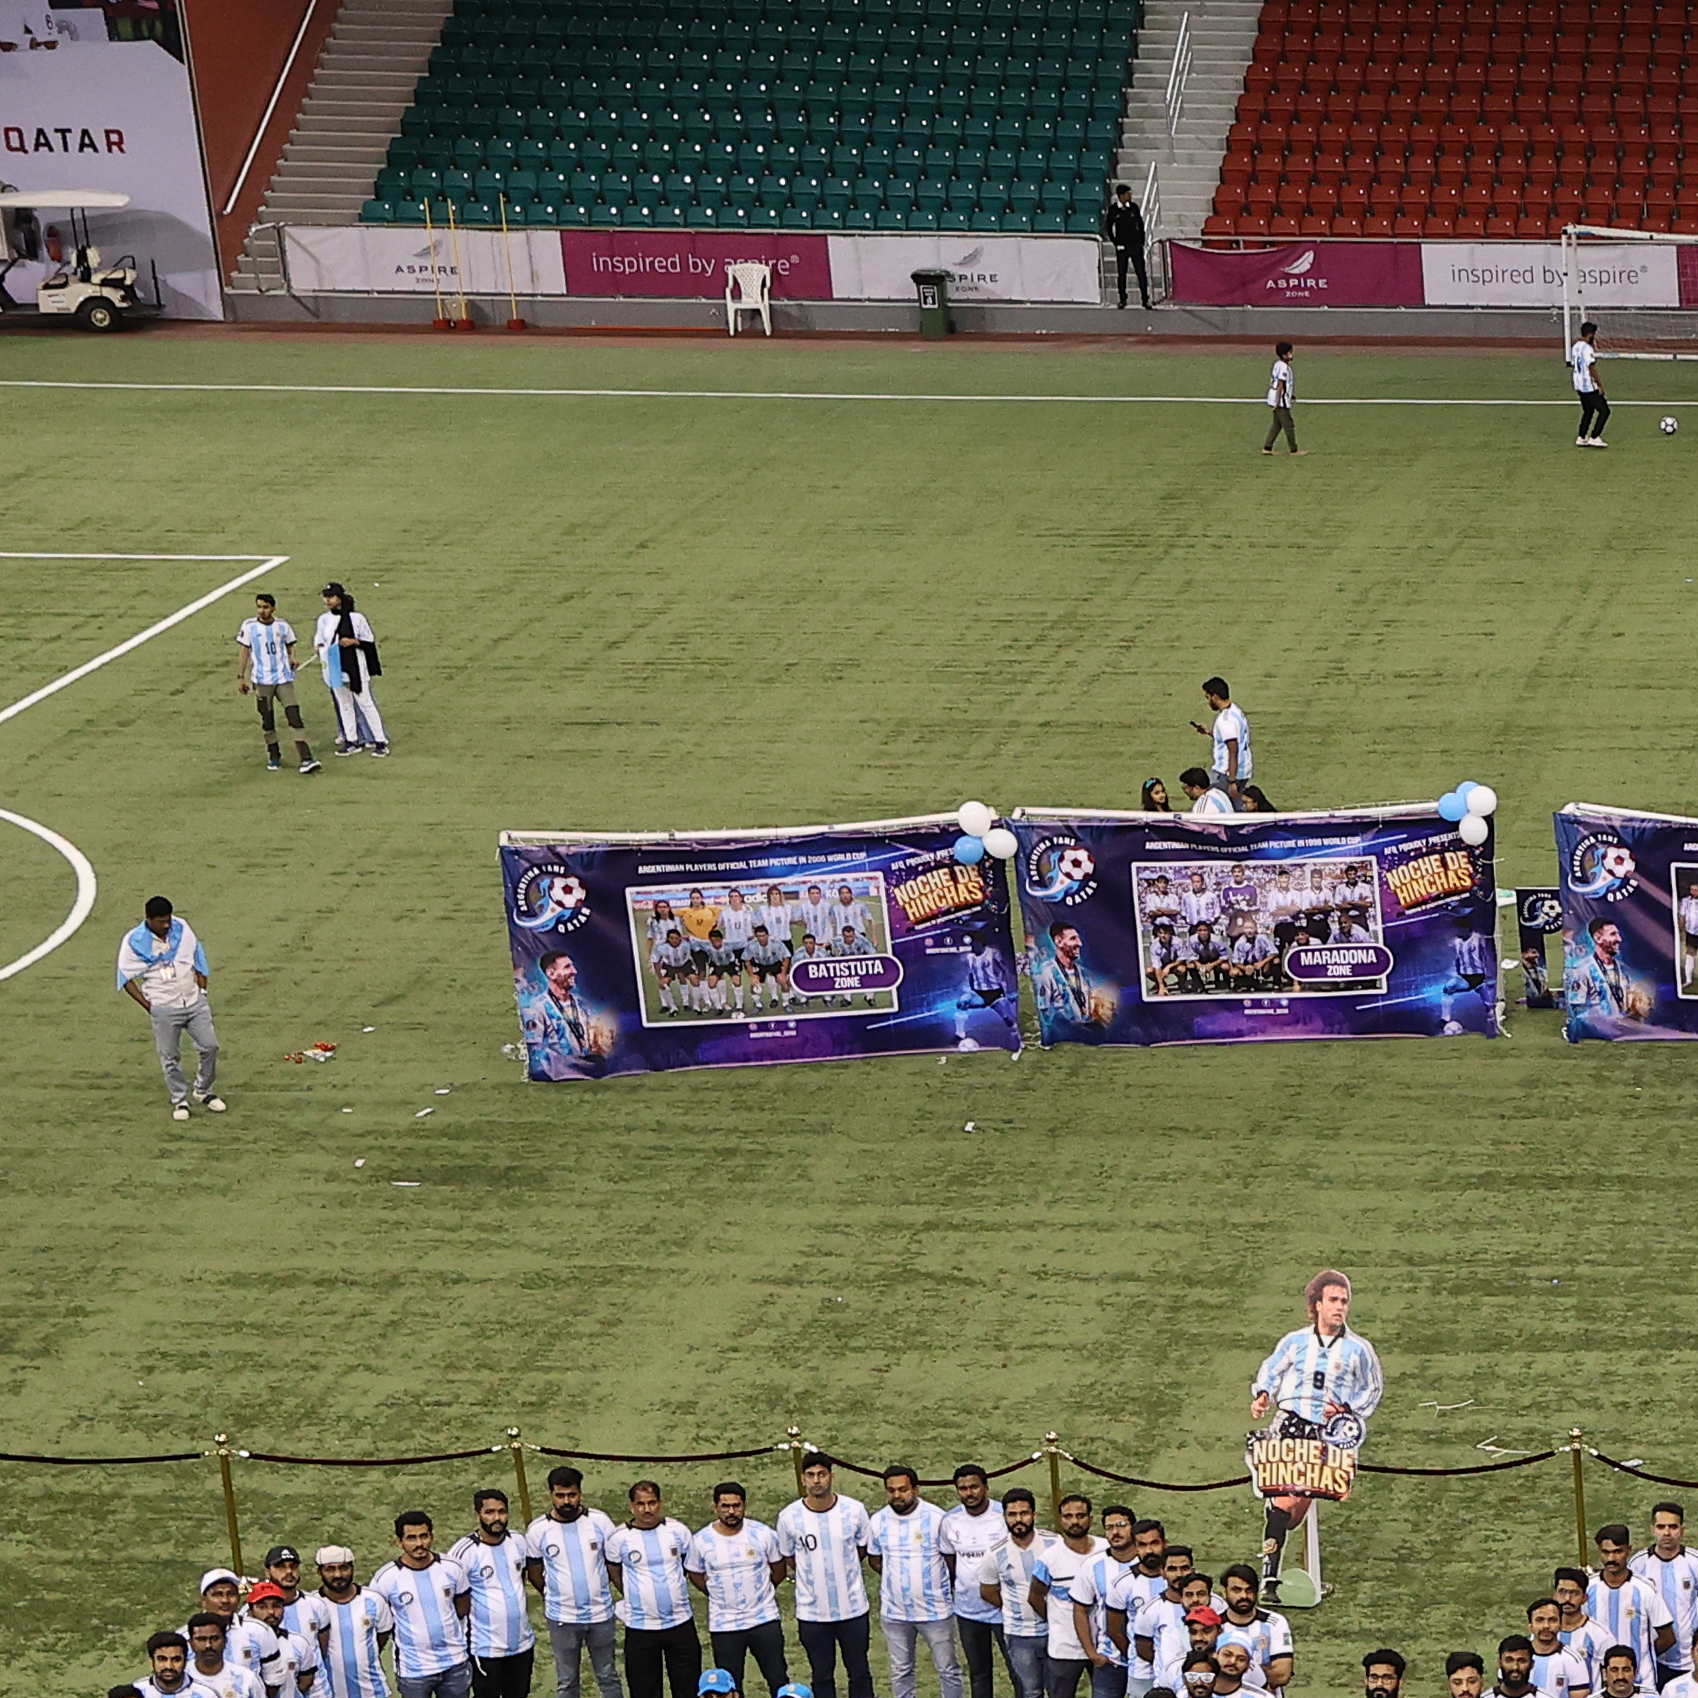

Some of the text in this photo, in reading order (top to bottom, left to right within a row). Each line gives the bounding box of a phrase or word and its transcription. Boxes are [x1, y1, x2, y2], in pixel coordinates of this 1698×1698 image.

[3, 126, 126, 154] QATAR
[394, 264, 458, 276] ASPIRE
[592, 252, 716, 276] inspired by
[949, 272, 999, 283] SPIRE
[1266, 277, 1328, 289] ASPIRE
[1450, 264, 1638, 287] inspired by aspire
[1285, 290, 1311, 299] ZONE
[265, 639, 277, 656] 10
[749, 859, 769, 869] TEAM
[1385, 851, 1472, 891] NOCHE DE
[893, 864, 982, 907] NOCHE DE
[1395, 869, 1473, 907] HINCHAS
[903, 881, 984, 922] HINCHAS
[1300, 949, 1378, 966] MARADONA
[807, 959, 884, 979] BATISTUTA
[1326, 965, 1353, 977] ZONE
[834, 976, 862, 989] ZONE
[1313, 1371, 1326, 1390] 9
[1253, 1438, 1356, 1472] NOCHE DE
[1257, 1462, 1351, 1494] HINCHAS
